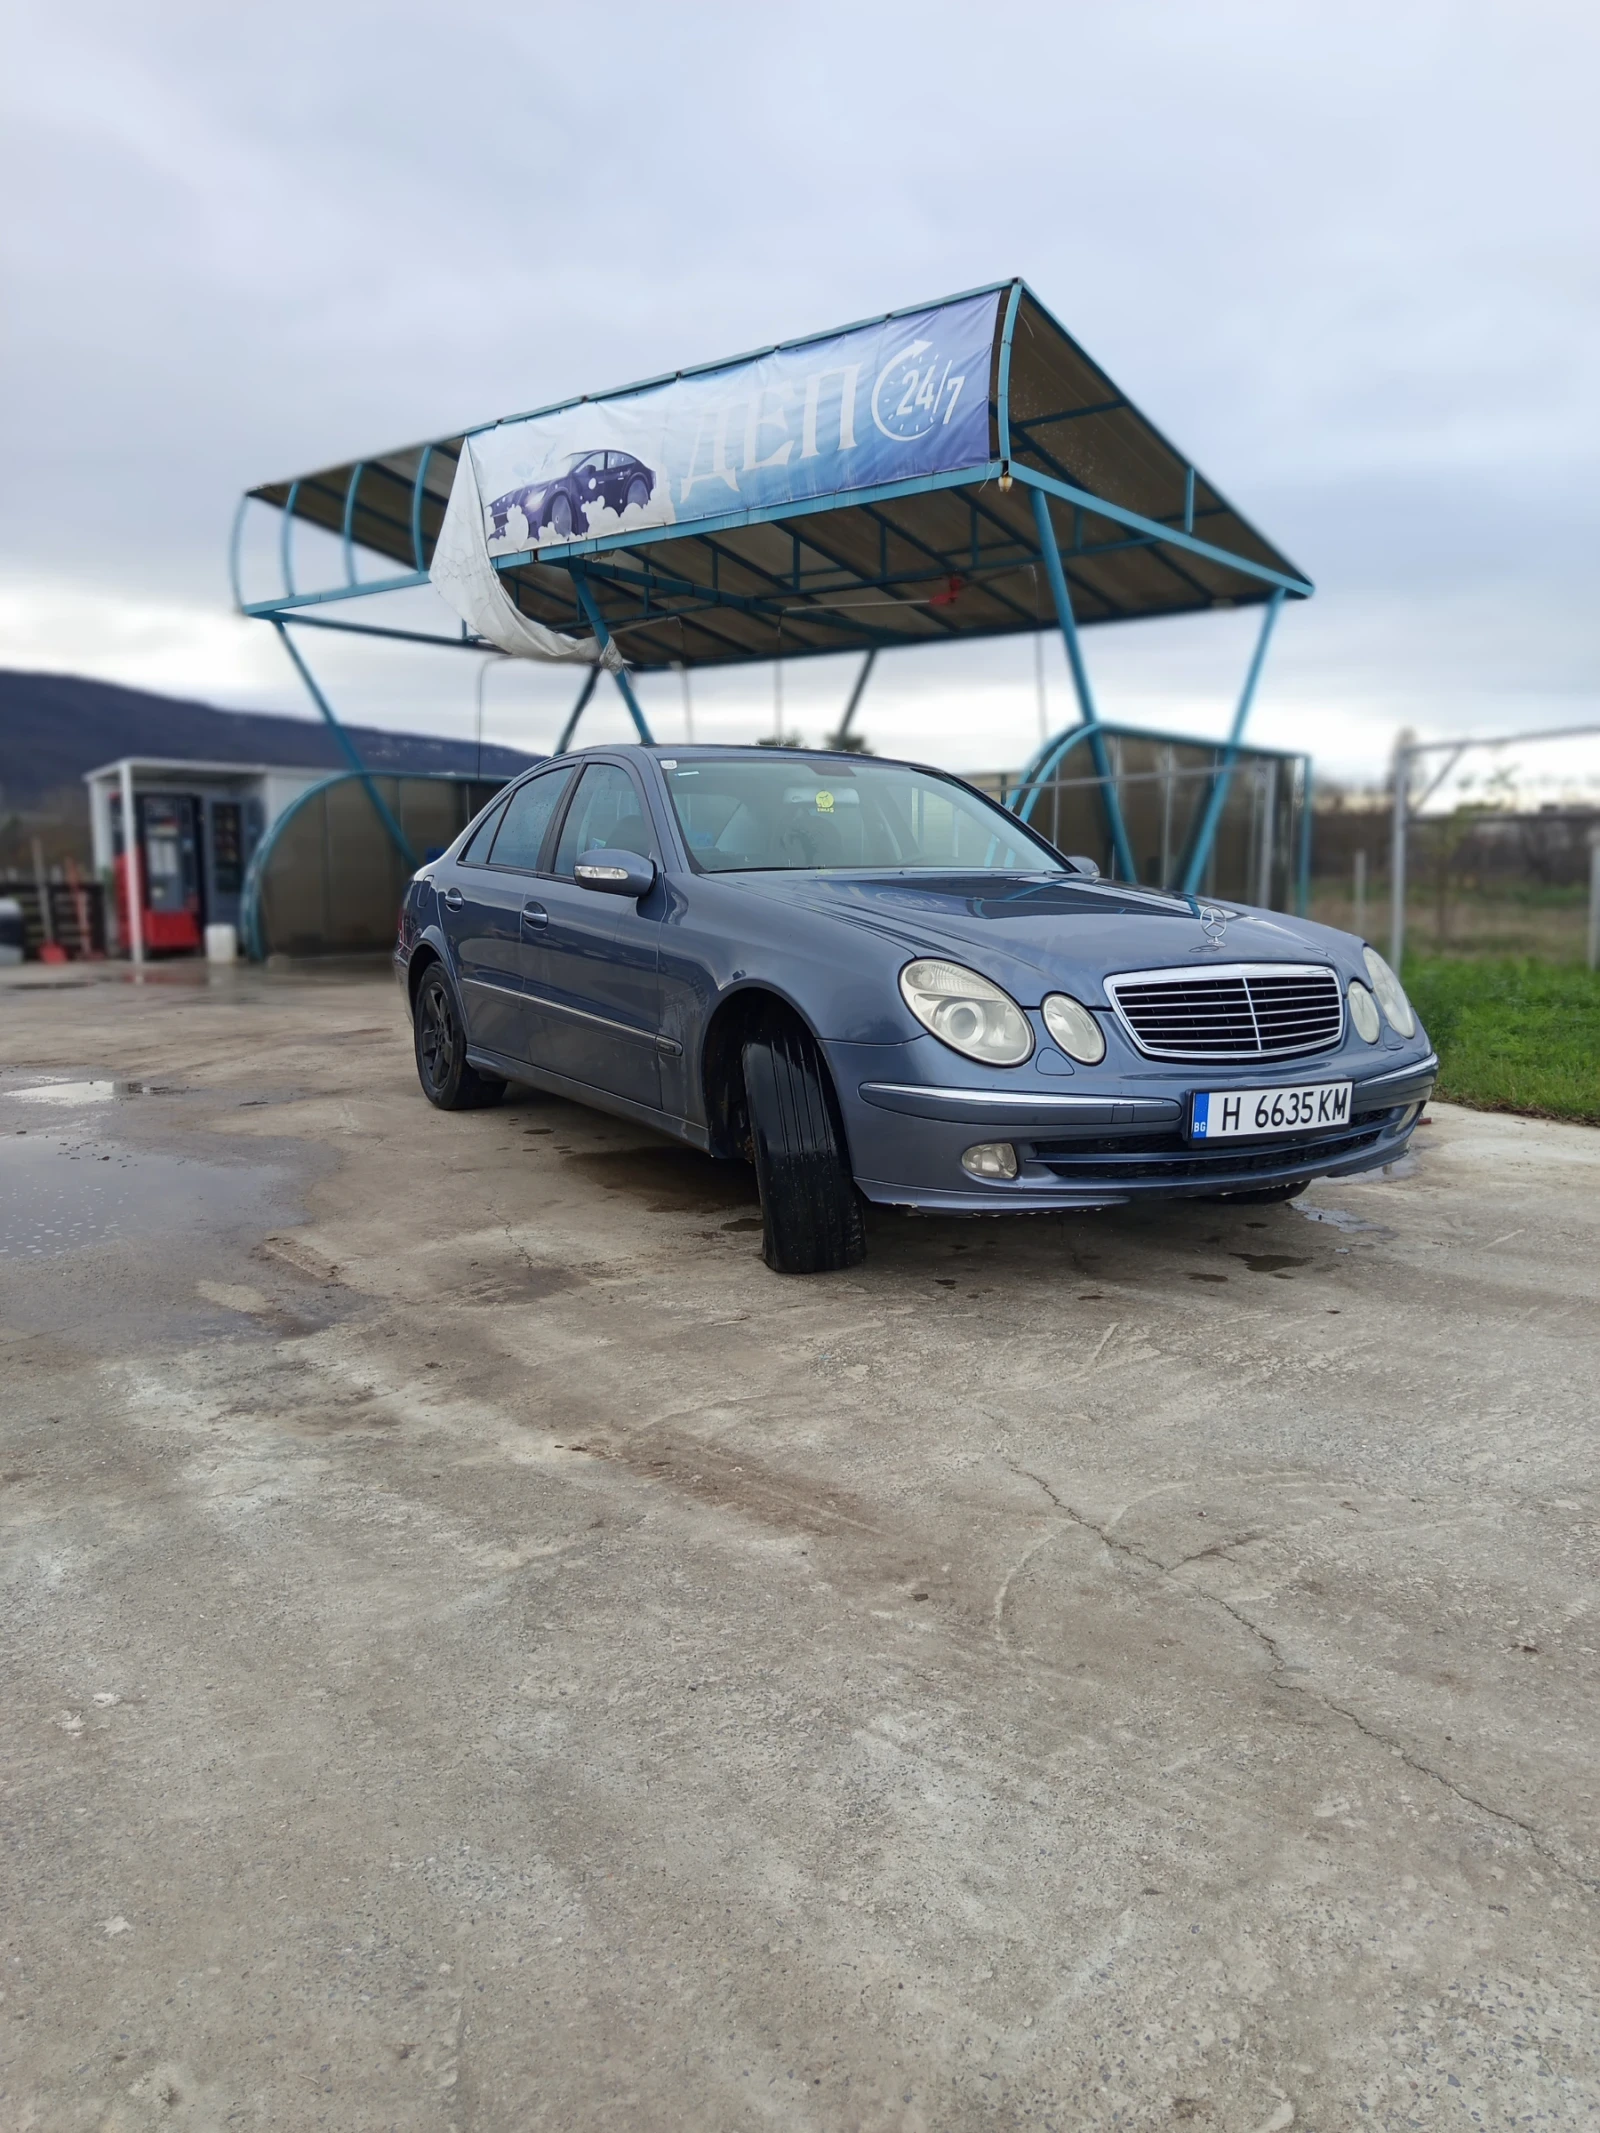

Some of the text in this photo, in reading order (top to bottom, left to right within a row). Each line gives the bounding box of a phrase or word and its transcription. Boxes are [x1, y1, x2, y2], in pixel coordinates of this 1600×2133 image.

[896, 359, 965, 425] 24/7
[680, 362, 862, 504] ДЕП
[1193, 1121, 1206, 1133] BG
